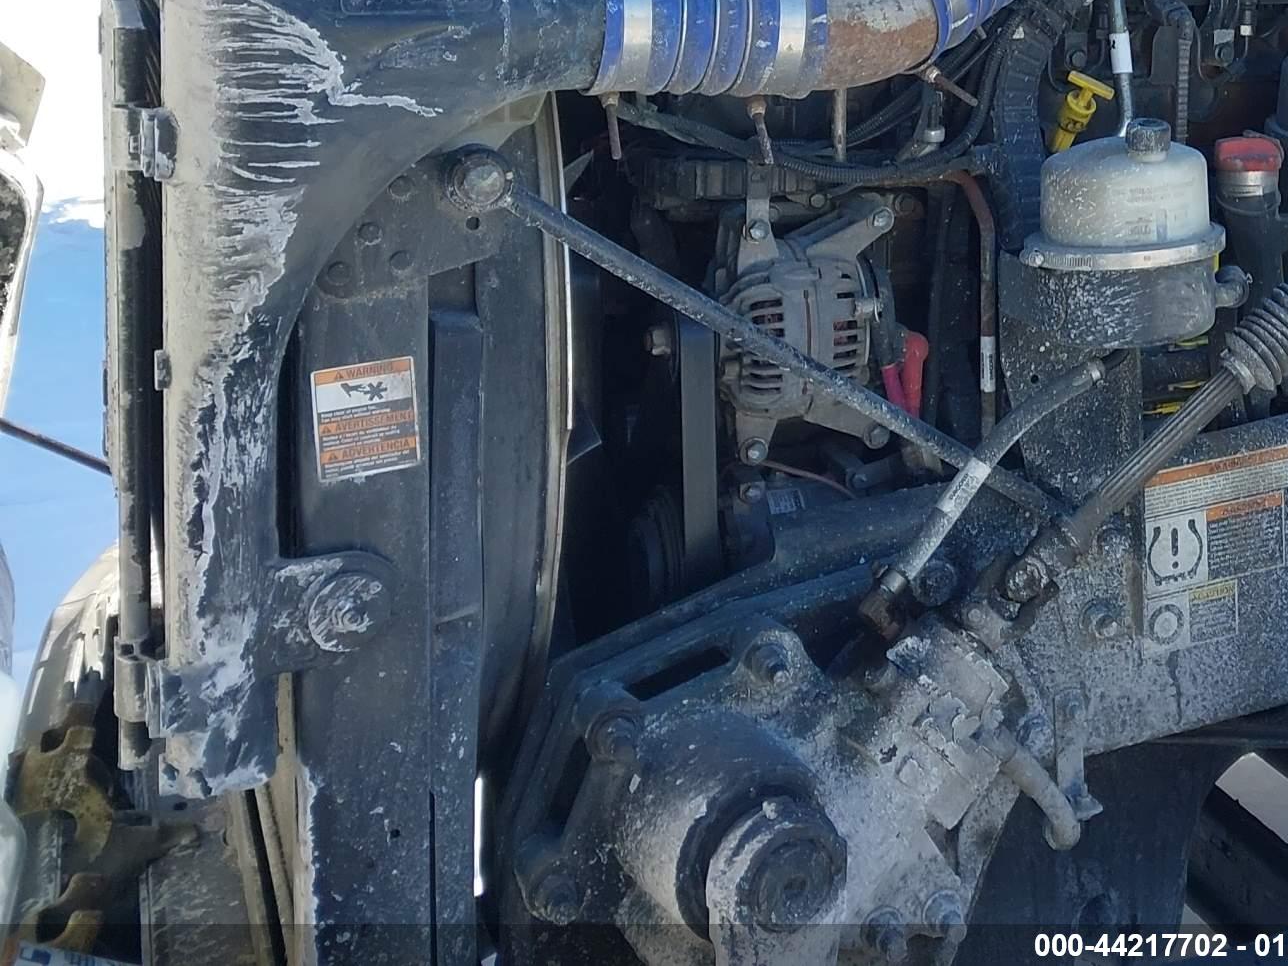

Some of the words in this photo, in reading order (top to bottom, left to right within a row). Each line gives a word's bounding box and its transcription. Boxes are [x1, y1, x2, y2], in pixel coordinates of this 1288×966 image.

[346, 362, 394, 378] WARNING
[335, 412, 411, 431] AVERTISSEMENT
[342, 439, 410, 458] ADVERTENCIA
